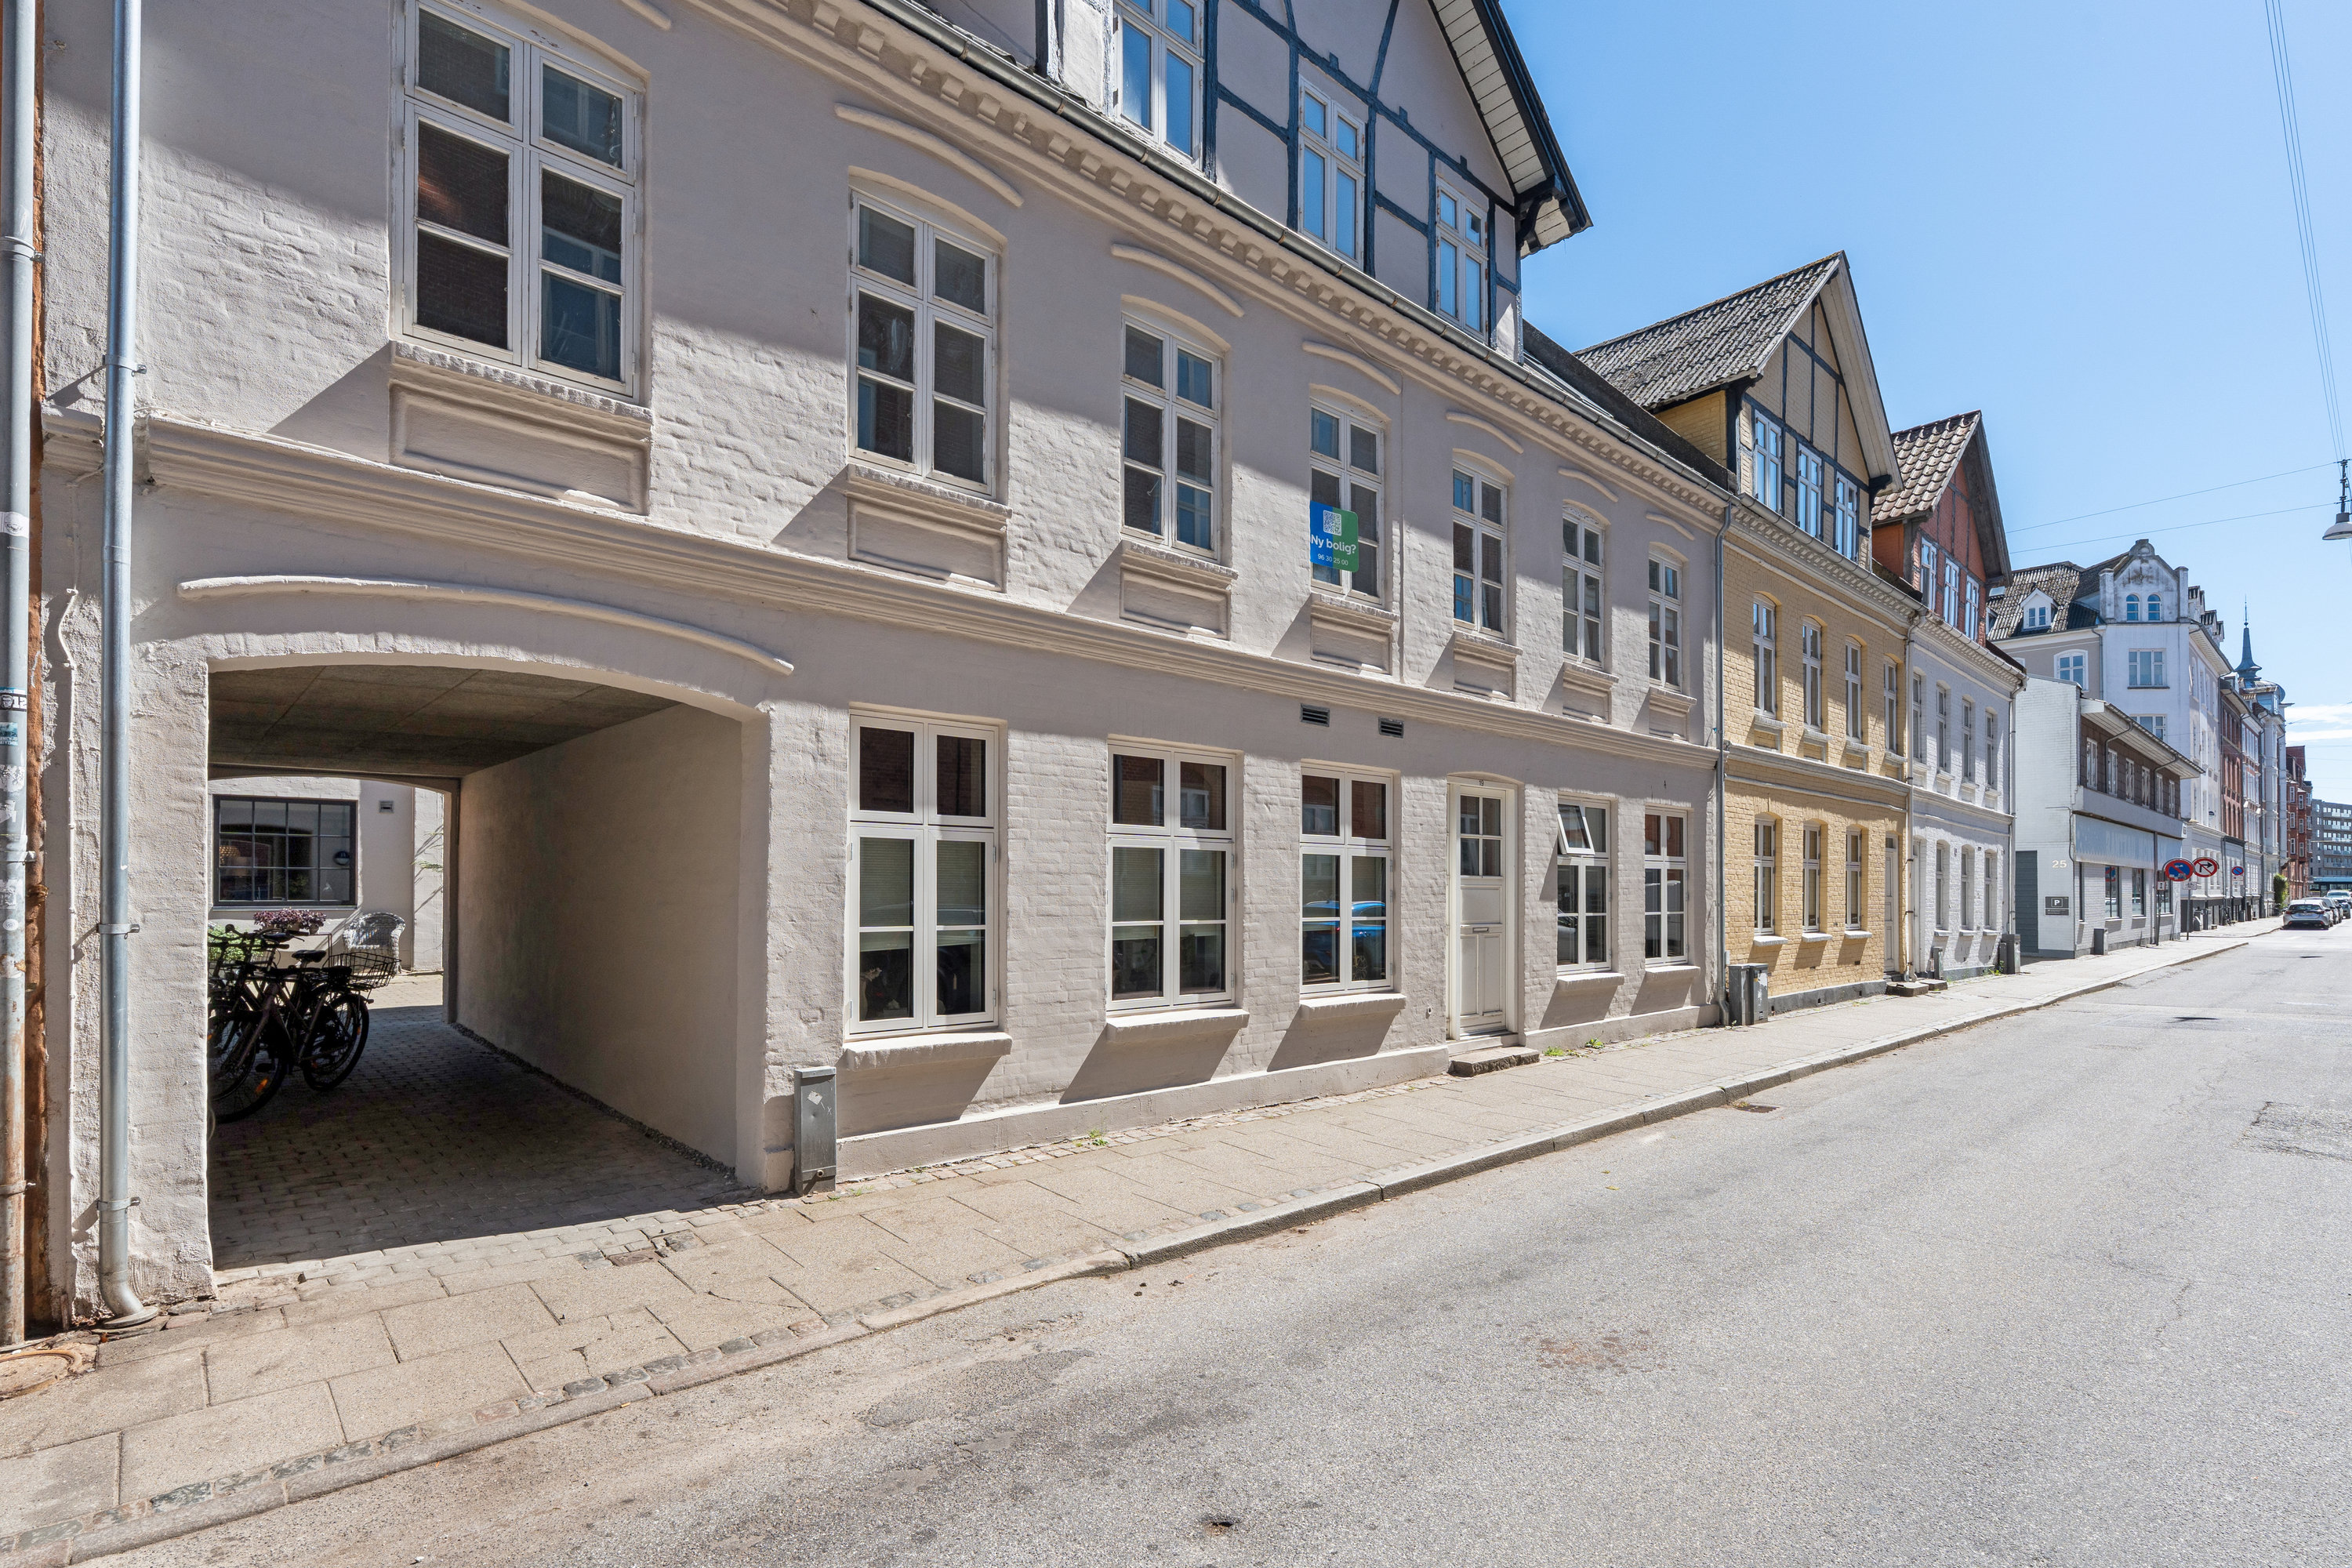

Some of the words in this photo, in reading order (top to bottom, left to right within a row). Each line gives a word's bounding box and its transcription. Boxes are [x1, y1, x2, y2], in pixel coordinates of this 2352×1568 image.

[1311, 534, 1324, 548] Ny
[1327, 538, 1356, 555] bolig?
[2052, 859, 2067, 868] 25
